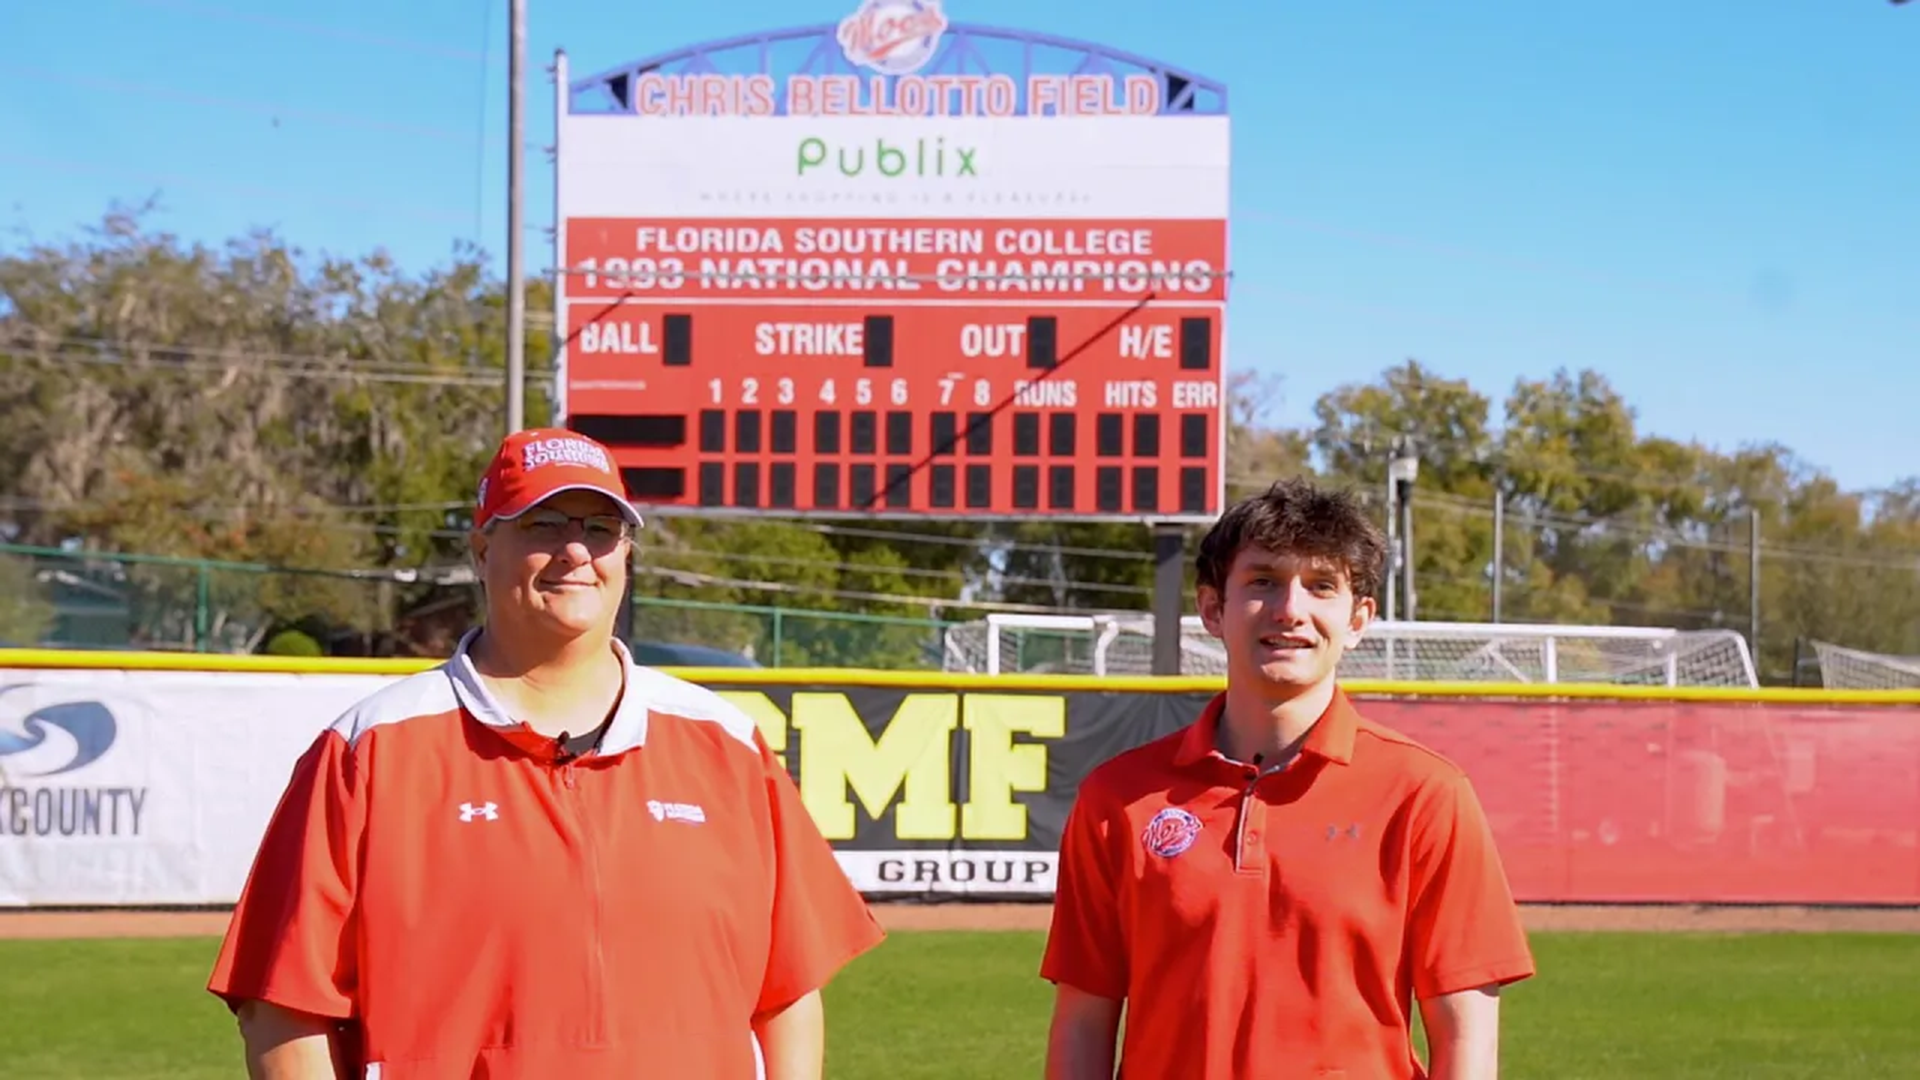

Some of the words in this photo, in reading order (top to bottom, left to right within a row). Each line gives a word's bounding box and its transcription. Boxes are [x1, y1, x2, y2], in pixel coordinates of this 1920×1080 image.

[634, 73, 776, 116] CHRIS
[787, 73, 1016, 116] BELLOTTO
[1028, 74, 1159, 116] FIELD
[797, 137, 977, 177] Publix
[636, 227, 783, 252] FLORIDA
[794, 228, 983, 253] SOUTHERN
[995, 229, 1152, 254] COLLEGE
[577, 257, 685, 290] 1993
[700, 258, 921, 290] NATIONAL
[935, 260, 1212, 292] CHAMPIONS
[580, 322, 659, 353] BALL
[754, 323, 864, 355] STRIKE
[960, 324, 1026, 357] OUT
[1119, 325, 1173, 359] H/E
[708, 378, 722, 404] 1
[741, 378, 759, 404] 2
[777, 378, 795, 404] 3
[818, 379, 836, 405] 4
[854, 379, 872, 405] 5
[890, 379, 908, 405] 6
[938, 380, 955, 406] 7
[973, 380, 991, 406] 8
[1013, 380, 1078, 407] RUNS
[1105, 381, 1158, 408] HITS
[1172, 382, 1218, 408] ERR
[878, 859, 1050, 883] GROUP
